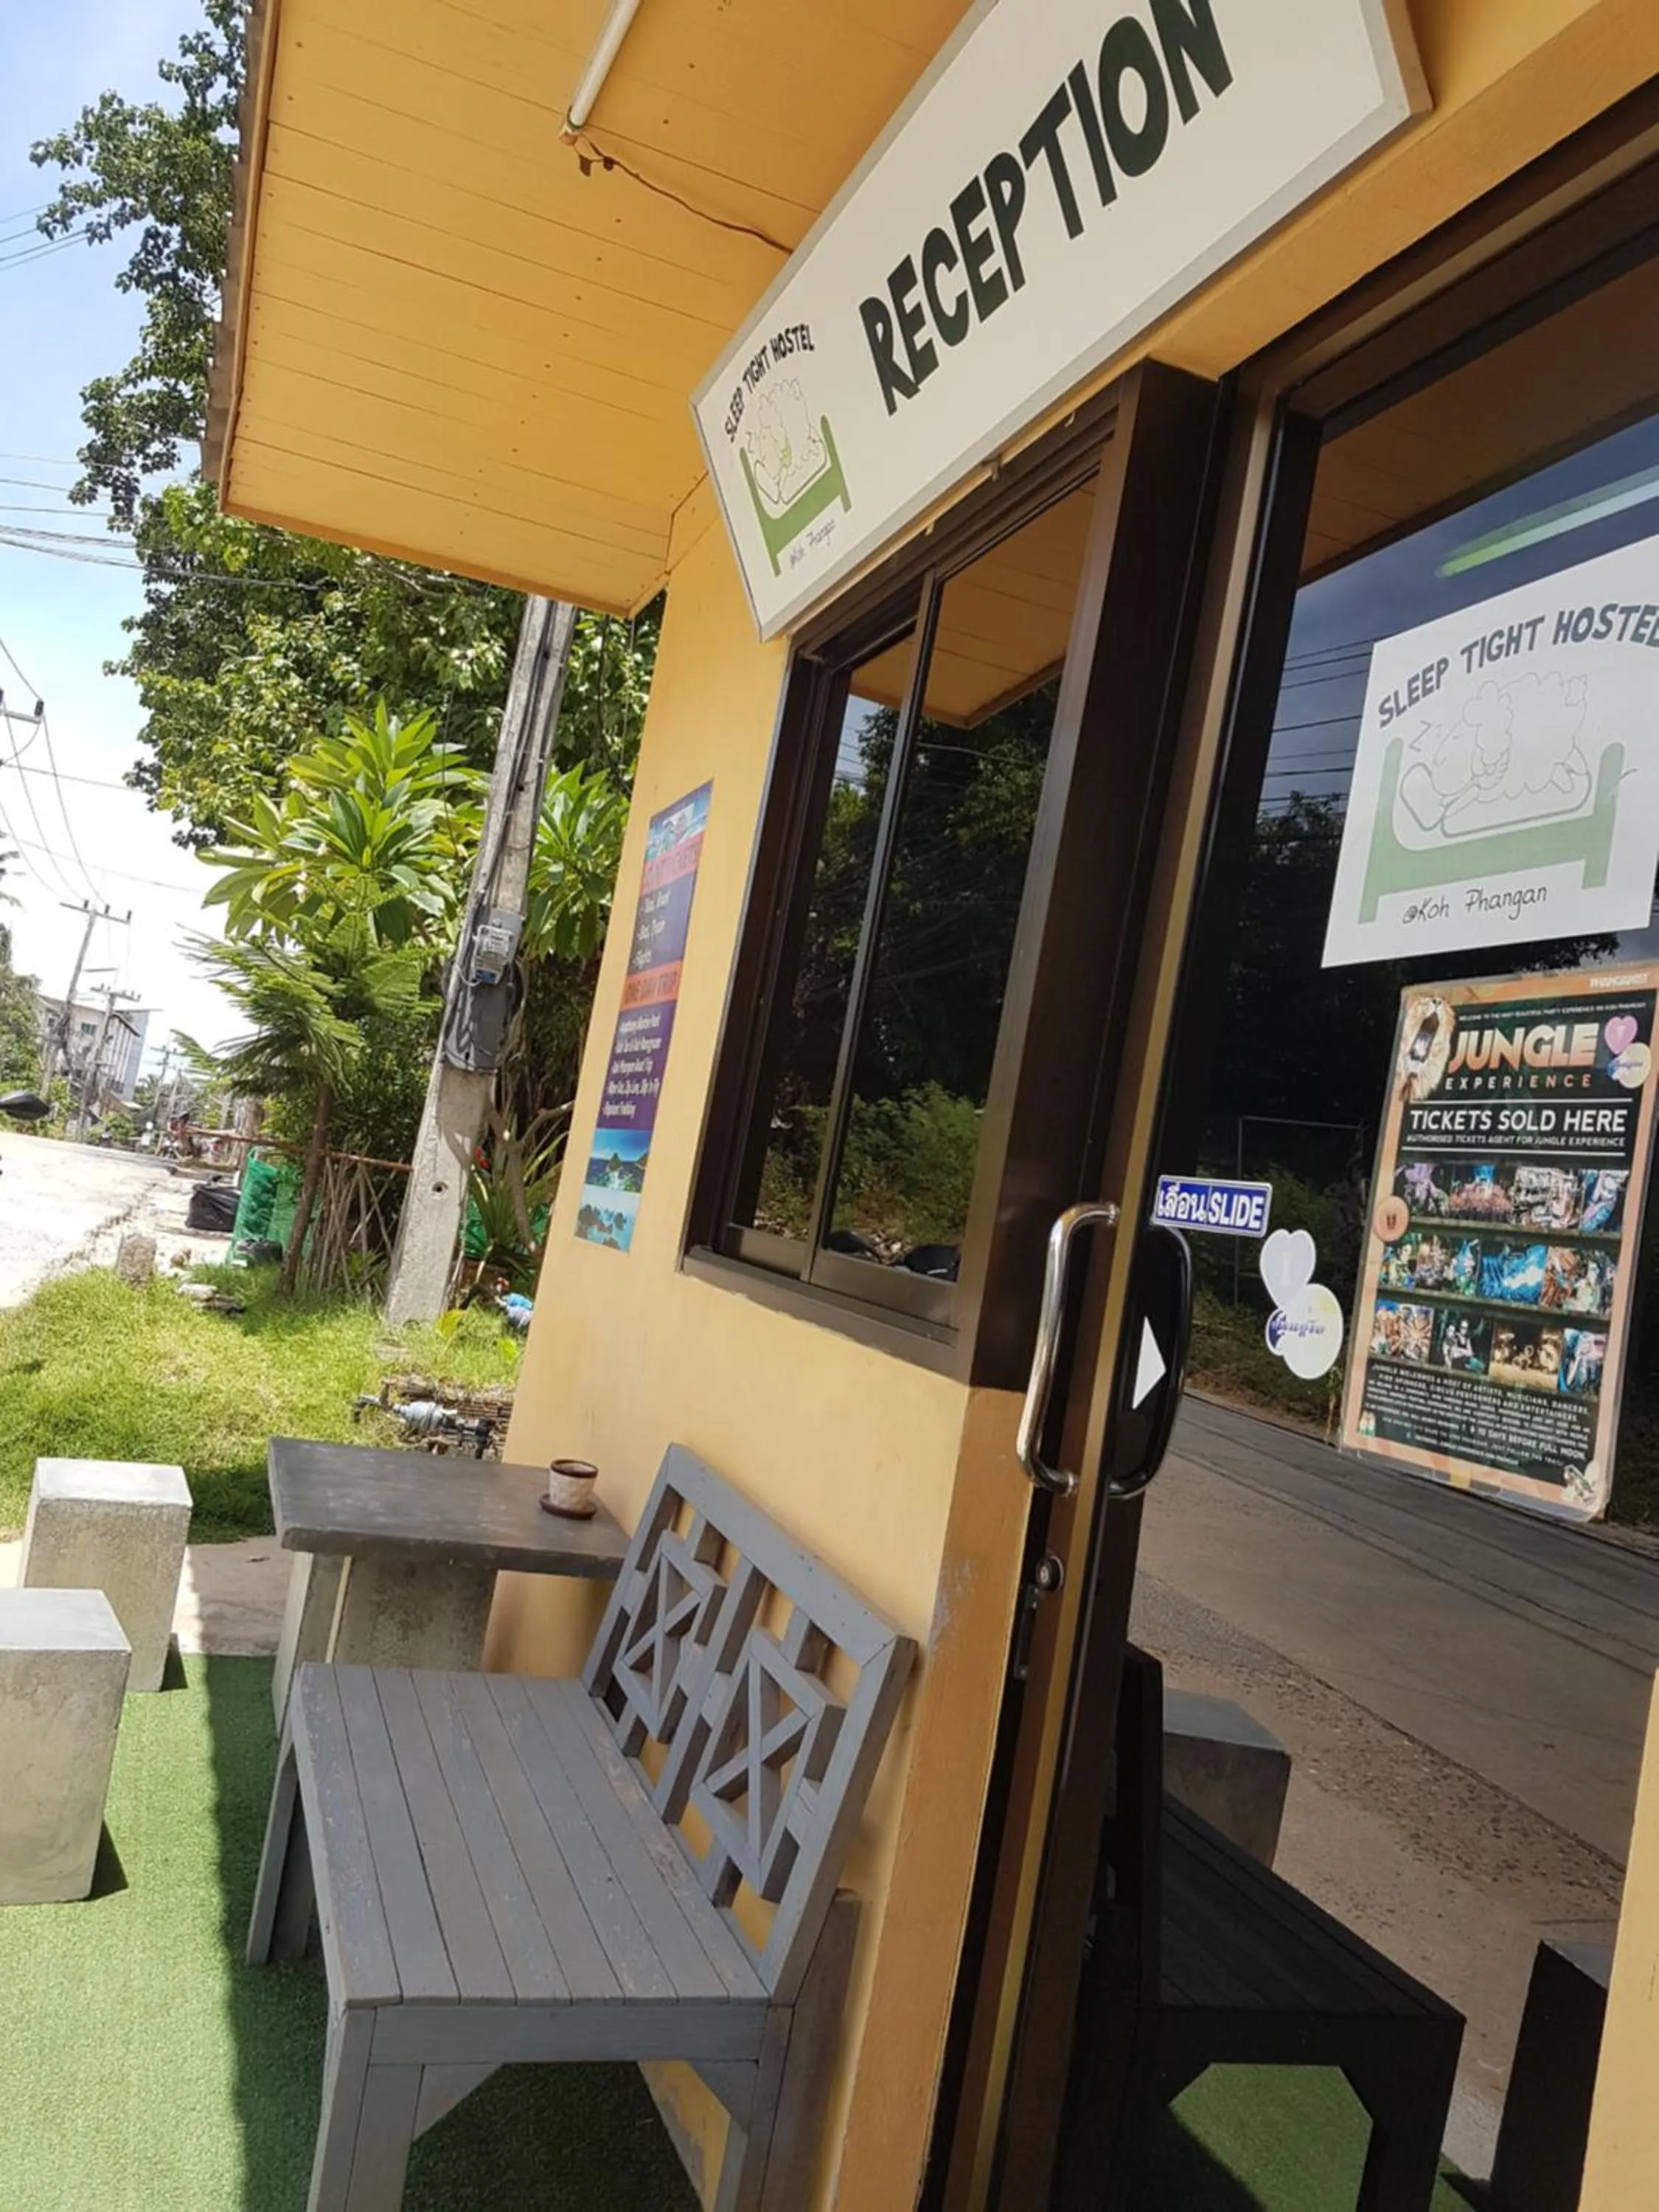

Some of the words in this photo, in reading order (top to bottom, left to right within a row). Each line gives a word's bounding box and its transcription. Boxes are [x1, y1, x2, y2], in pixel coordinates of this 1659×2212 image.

[859, 0, 1234, 417] RECEPTION
[724, 386, 745, 443] SLEEP
[742, 344, 771, 394] TIGHT
[769, 324, 814, 363] HOSTEL
[1378, 657, 1450, 728] SLEEP
[1460, 615, 1545, 674] TIGHT
[1402, 895, 1450, 924] @Koh
[1464, 886, 1547, 920] Phangan
[1448, 1023, 1599, 1074] JUNGLE
[1444, 1074, 1593, 1091] EXPERIENCE
[1410, 1110, 1492, 1132] TICKETS
[1498, 1110, 1556, 1132] SOLD
[1563, 1109, 1628, 1133] HERE
[1455, 1134, 1486, 1144] TICKETS
[1487, 1135, 1514, 1144] AGENT
[1516, 1135, 1533, 1145] FOR
[1534, 1135, 1566, 1146] JUNGLE
[1568, 1136, 1625, 1147] EXPERIENCE
[1208, 1192, 1265, 1229] SLIDE
